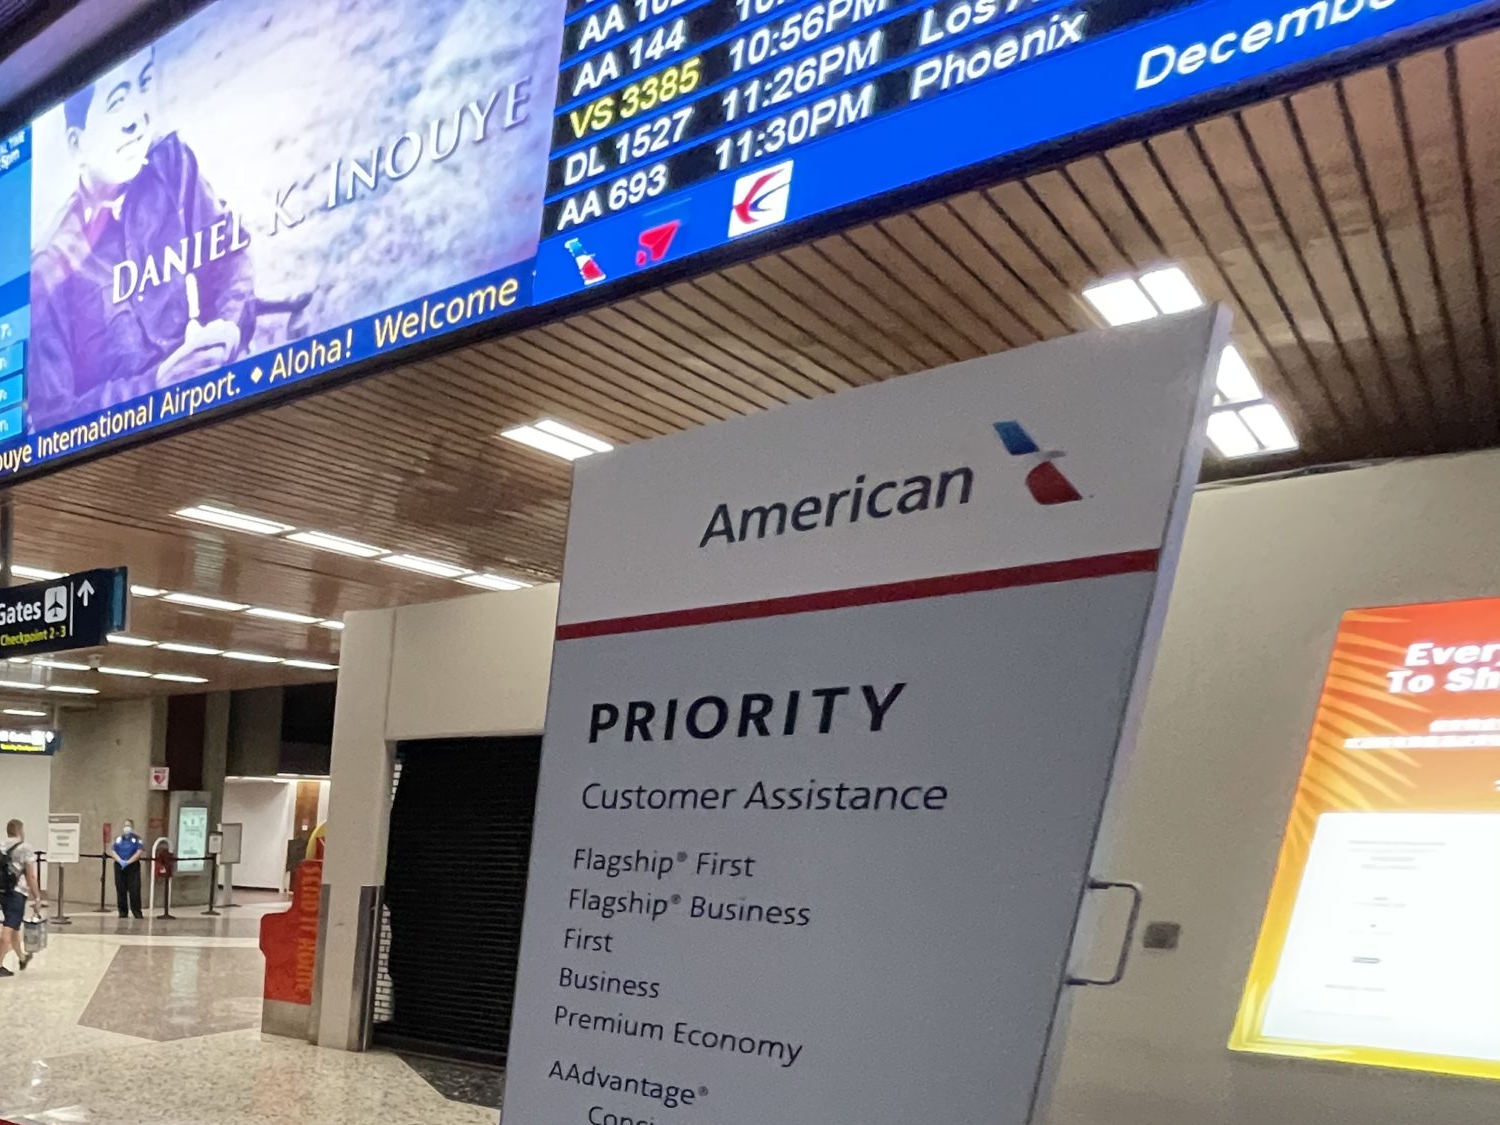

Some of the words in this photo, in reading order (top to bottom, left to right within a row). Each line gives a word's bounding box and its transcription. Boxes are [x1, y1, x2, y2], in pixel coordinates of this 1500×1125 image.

[578, 5, 624, 51] AA
[570, 97, 615, 138] VS
[620, 58, 700, 119] 3385
[729, 0, 886, 72] 10:56PM
[573, 52, 619, 97] AA
[630, 17, 686, 70] 144
[564, 147, 606, 186] DL
[615, 106, 695, 164] 1527
[722, 29, 883, 122] 11:26PM
[920, 0, 997, 45] Los
[557, 190, 602, 231] AA
[608, 164, 667, 211] 693
[714, 82, 875, 171] 11:30PM
[910, 11, 1087, 101] Phoenix
[111, 211, 251, 304] DANIEL
[328, 76, 532, 209] INOUYE
[37, 396, 154, 459] International
[160, 371, 241, 419] Airport.
[269, 328, 353, 383] Aloha!
[374, 278, 519, 348] Welcome
[699, 464, 975, 549] American
[0, 629, 48, 647] Checkpoint
[1405, 642, 1500, 666] Ever
[1386, 669, 1435, 694] To
[587, 682, 908, 744] PRIORITY
[581, 781, 737, 811] Customer
[744, 778, 948, 811] Assistance
[696, 852, 757, 878] First
[690, 896, 812, 927] Business
[563, 927, 614, 954] First
[559, 967, 661, 999] Business
[555, 1006, 664, 1041] Premium
[673, 1022, 803, 1068] Economy
